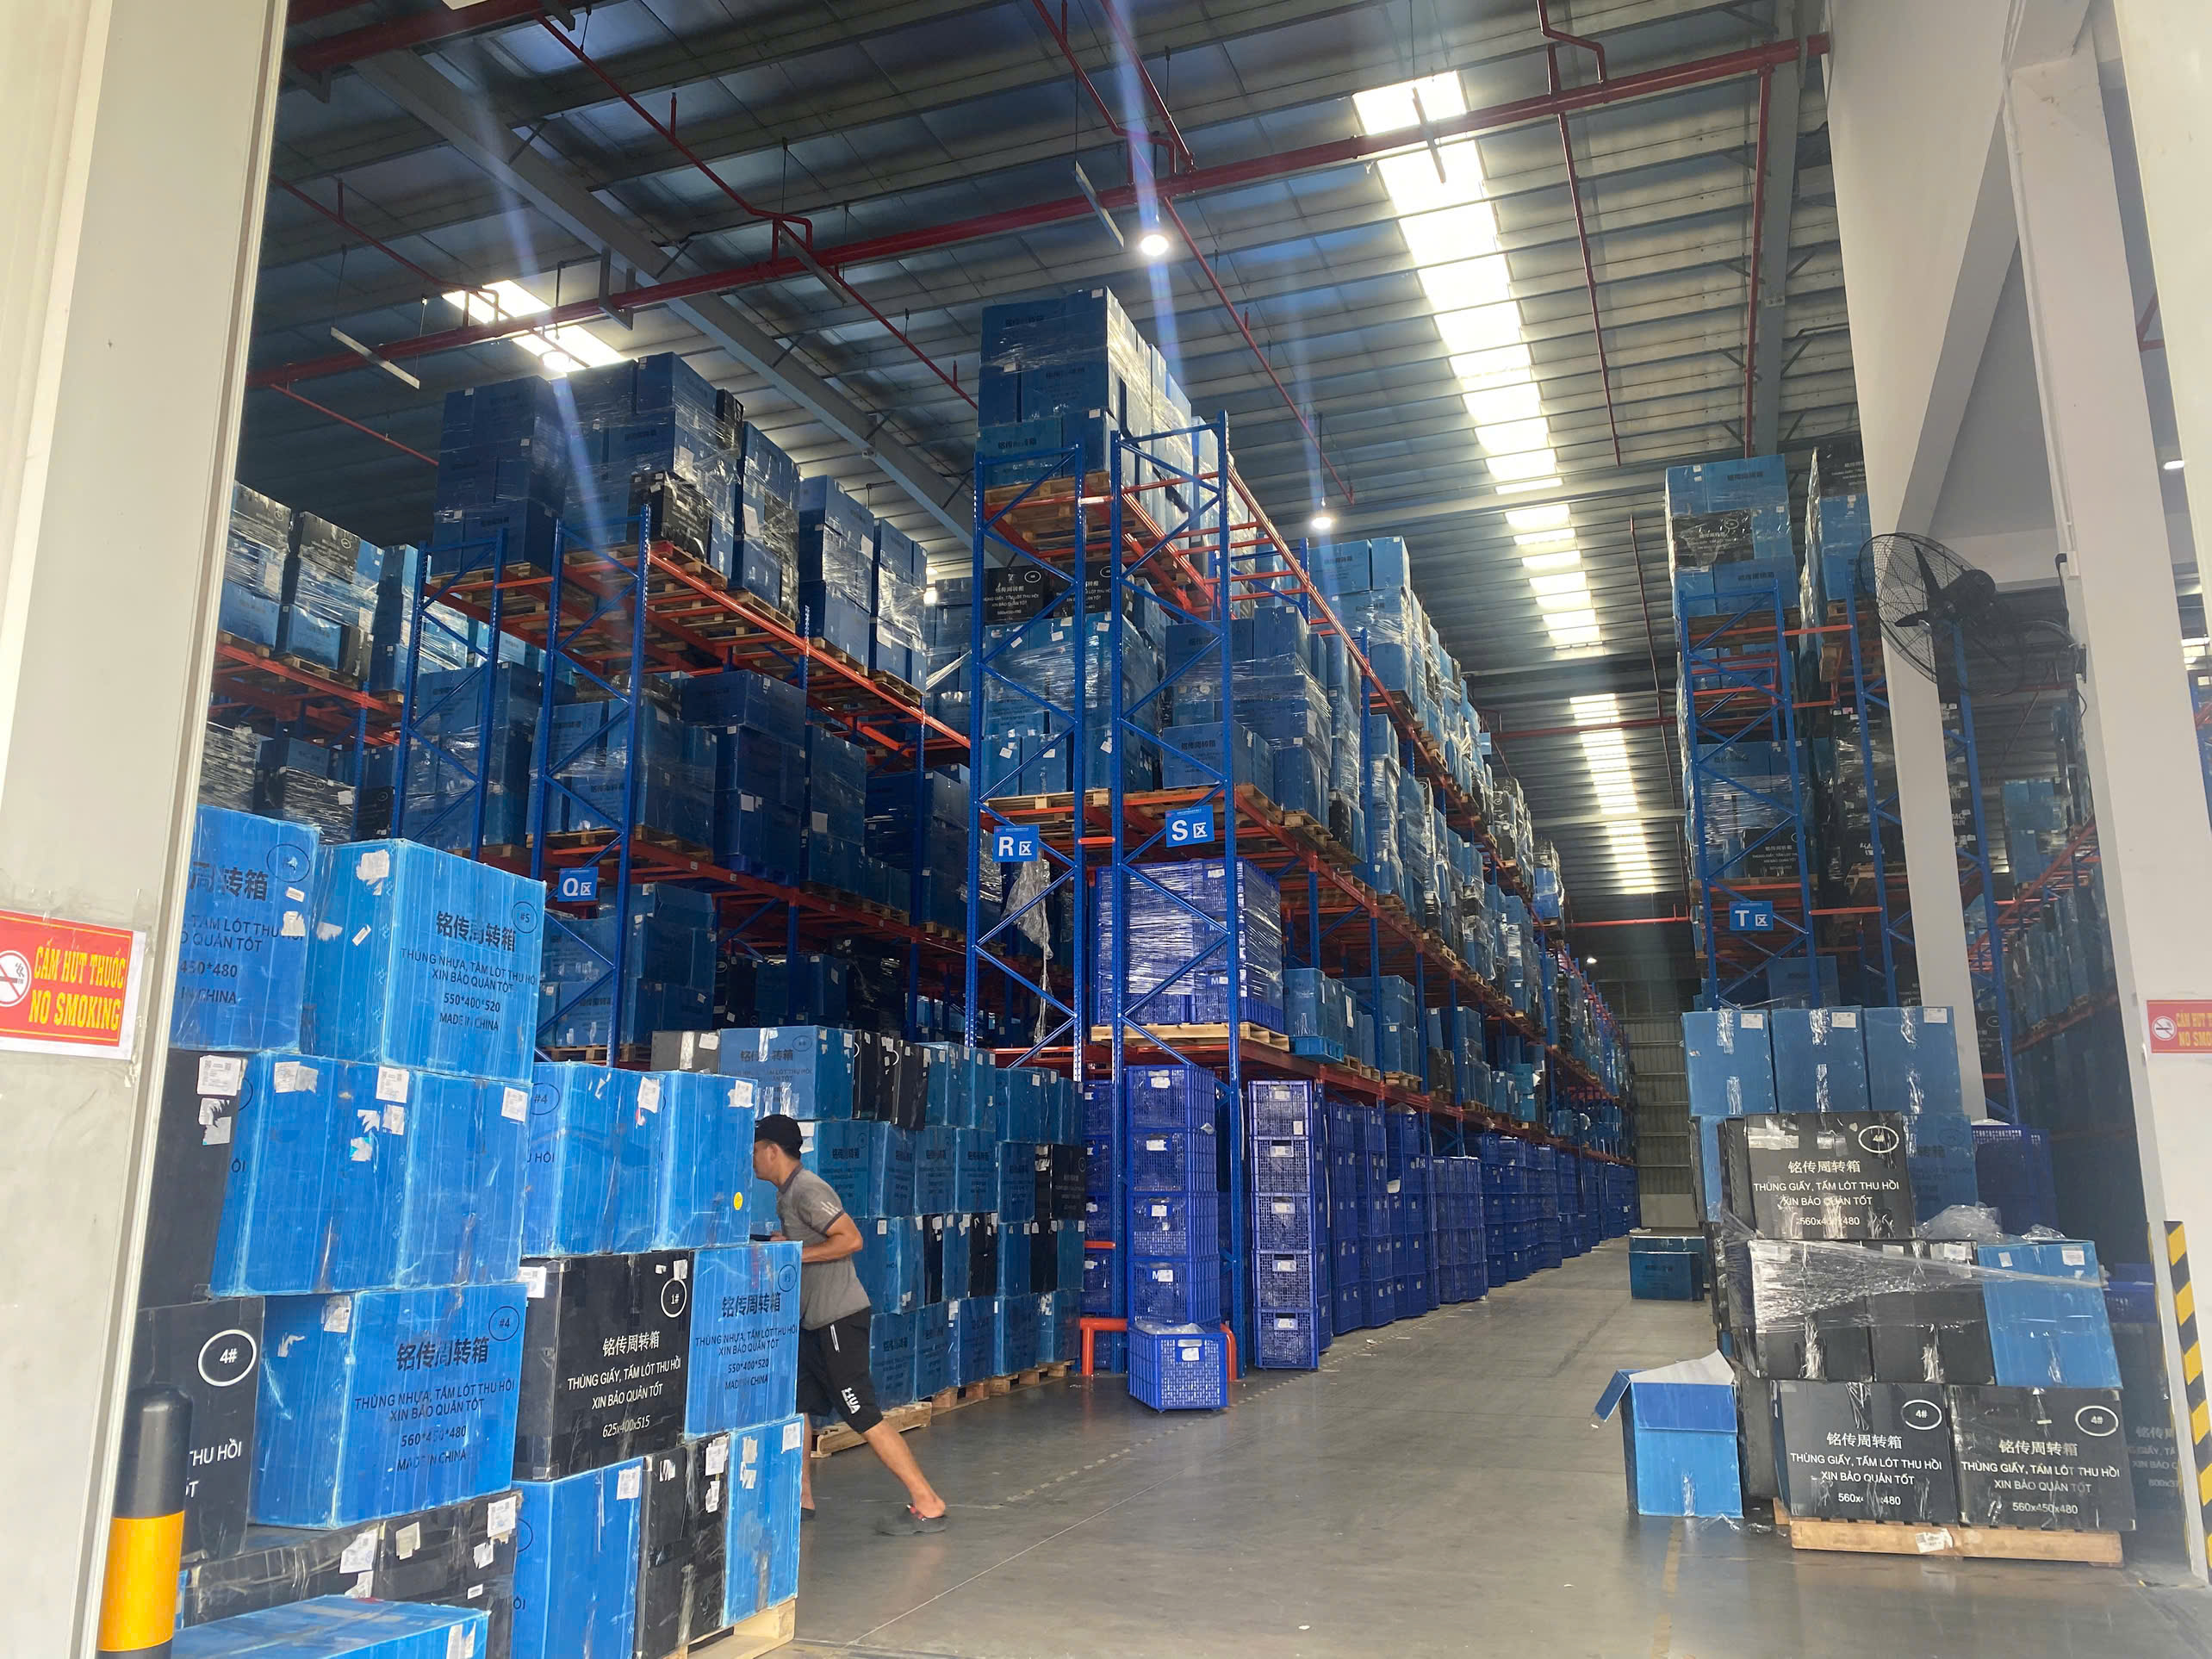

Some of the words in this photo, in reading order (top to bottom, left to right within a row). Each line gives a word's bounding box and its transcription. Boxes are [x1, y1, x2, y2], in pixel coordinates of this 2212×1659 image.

[519, 912, 531, 923] #5
[254, 923, 281, 937] THU
[432, 968, 449, 981] XIN
[508, 969, 524, 983] THU
[28, 989, 52, 1024] NO
[53, 991, 121, 1031] SMOKING
[534, 1094, 548, 1103] #4
[1788, 1160, 1861, 1173] 铭传周转箱
[1754, 1181, 1786, 1191] THÙNG
[1859, 1182, 1880, 1190] THU
[1882, 1178, 1899, 1190] HỒI
[1853, 1195, 1873, 1206] TỐT
[670, 1294, 680, 1305] 1#
[722, 1292, 781, 1318] 铭传周转箱
[499, 1318, 510, 1329] #4
[602, 1330, 660, 1357] 铭传周转箱
[718, 1345, 731, 1356] XIN
[220, 1348, 237, 1364] 4#
[568, 1373, 598, 1391] THÙNG
[656, 1359, 669, 1373] THU
[670, 1355, 681, 1370] HỒI
[477, 1381, 497, 1395] THU
[725, 1378, 742, 1390] MAD
[592, 1395, 606, 1410] XIN
[607, 1389, 625, 1407] BẢO
[649, 1380, 663, 1397] TỐT
[390, 1407, 409, 1421] XIN
[2091, 1415, 2103, 1425] 4#
[602, 1414, 650, 1438] 625x400x515
[1827, 1432, 1903, 1450] 铭传周转箱
[1998, 1439, 2078, 1457] 铭传周转箱
[217, 1438, 242, 1461] HỒI
[397, 1455, 426, 1472] MAD
[1790, 1451, 1825, 1464] THÙNG
[1856, 1456, 1877, 1467] TẤM
[1901, 1459, 1922, 1469] THU
[1924, 1457, 1942, 1470] HỒI
[1960, 1460, 1998, 1473] THÙNG
[2078, 1467, 2098, 1477] THU
[2101, 1465, 2120, 1477] HỒI
[1821, 1470, 1838, 1481] XIN
[1840, 1471, 1861, 1482] BẢO
[1894, 1473, 1915, 1485] TỐT
[1994, 1479, 2011, 1489] XIN
[1838, 1493, 1901, 1506] 560x480
[2012, 1502, 2078, 1514] 560x450x480
